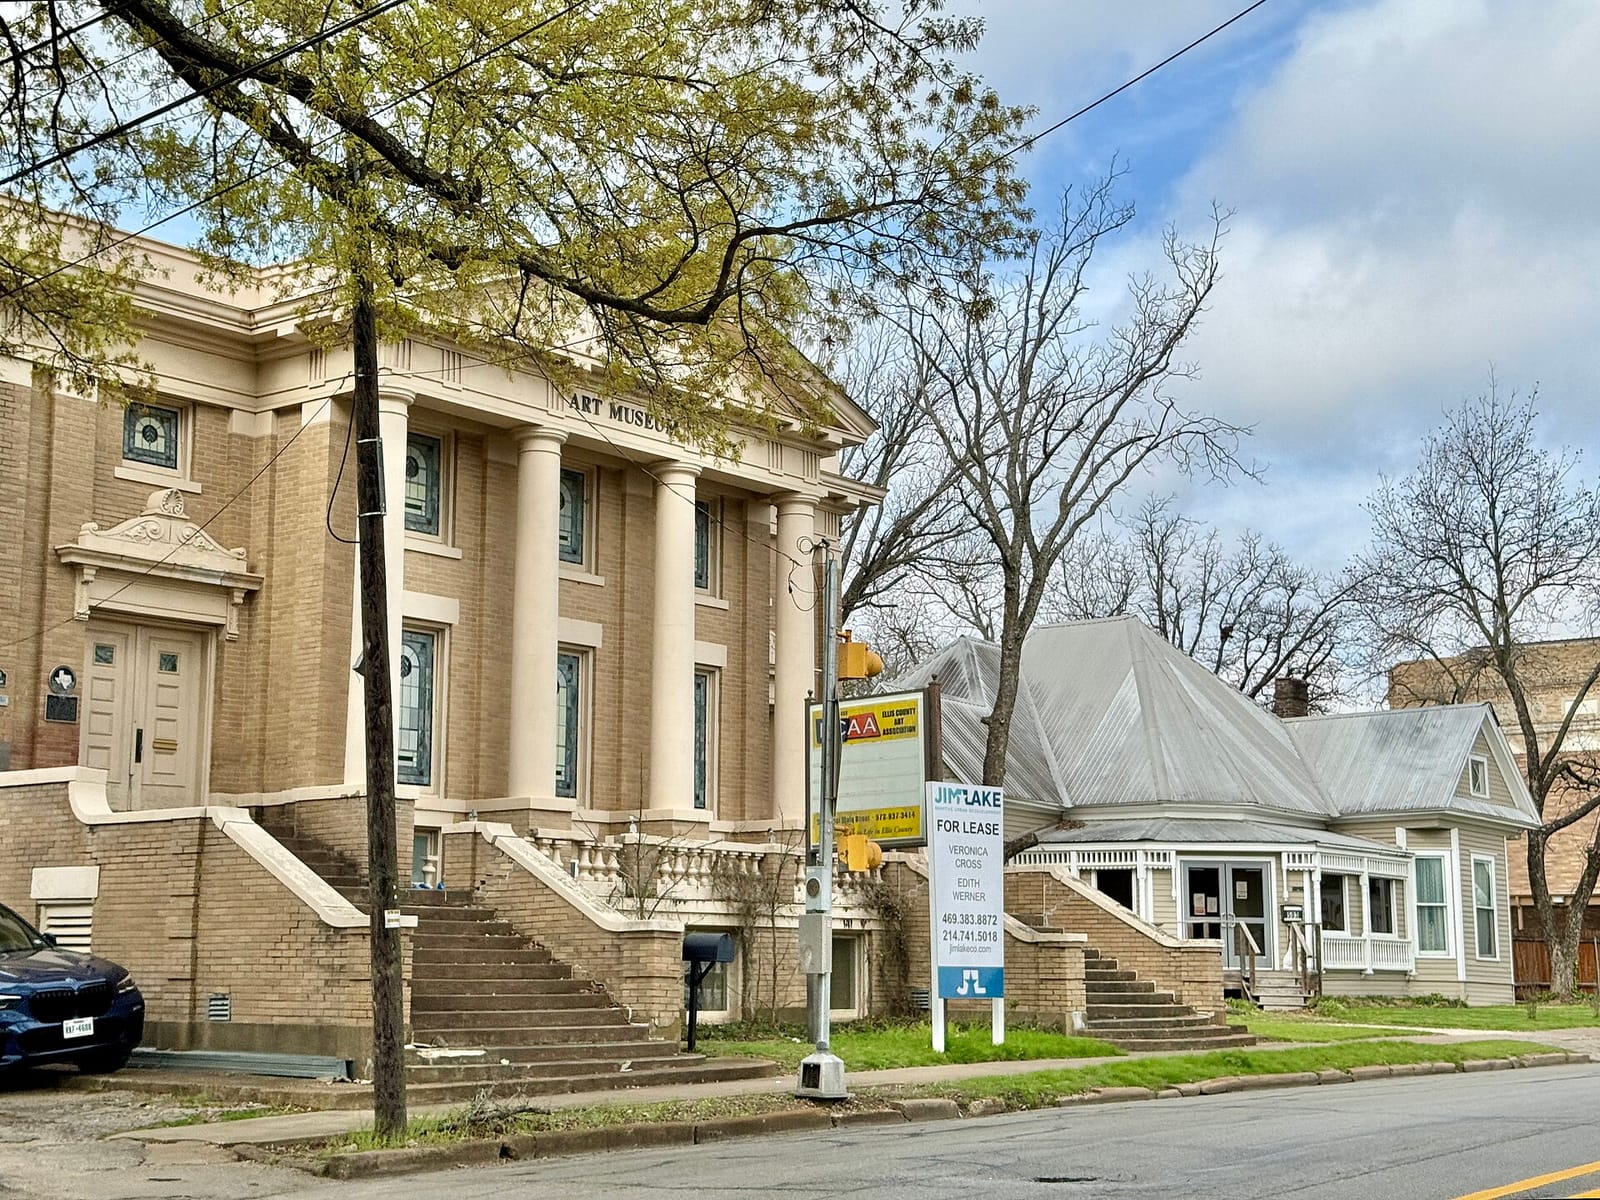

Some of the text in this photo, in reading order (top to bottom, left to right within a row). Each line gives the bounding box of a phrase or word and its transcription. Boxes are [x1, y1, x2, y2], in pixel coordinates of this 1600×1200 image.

[569, 393, 603, 415] ART
[896, 708, 916, 716] COUNTY
[882, 726, 916, 736] ASSOCIATION
[937, 819, 1000, 836] FOR LEASE
[949, 844, 988, 856] VERONICA
[955, 858, 982, 869] CROSS
[957, 878, 980, 888] EDITH
[953, 891, 986, 902] WERNER
[942, 913, 998, 926] 469.383.8872
[943, 930, 998, 942] 214.741.5018
[949, 943, 992, 955] jimlakeco.com
